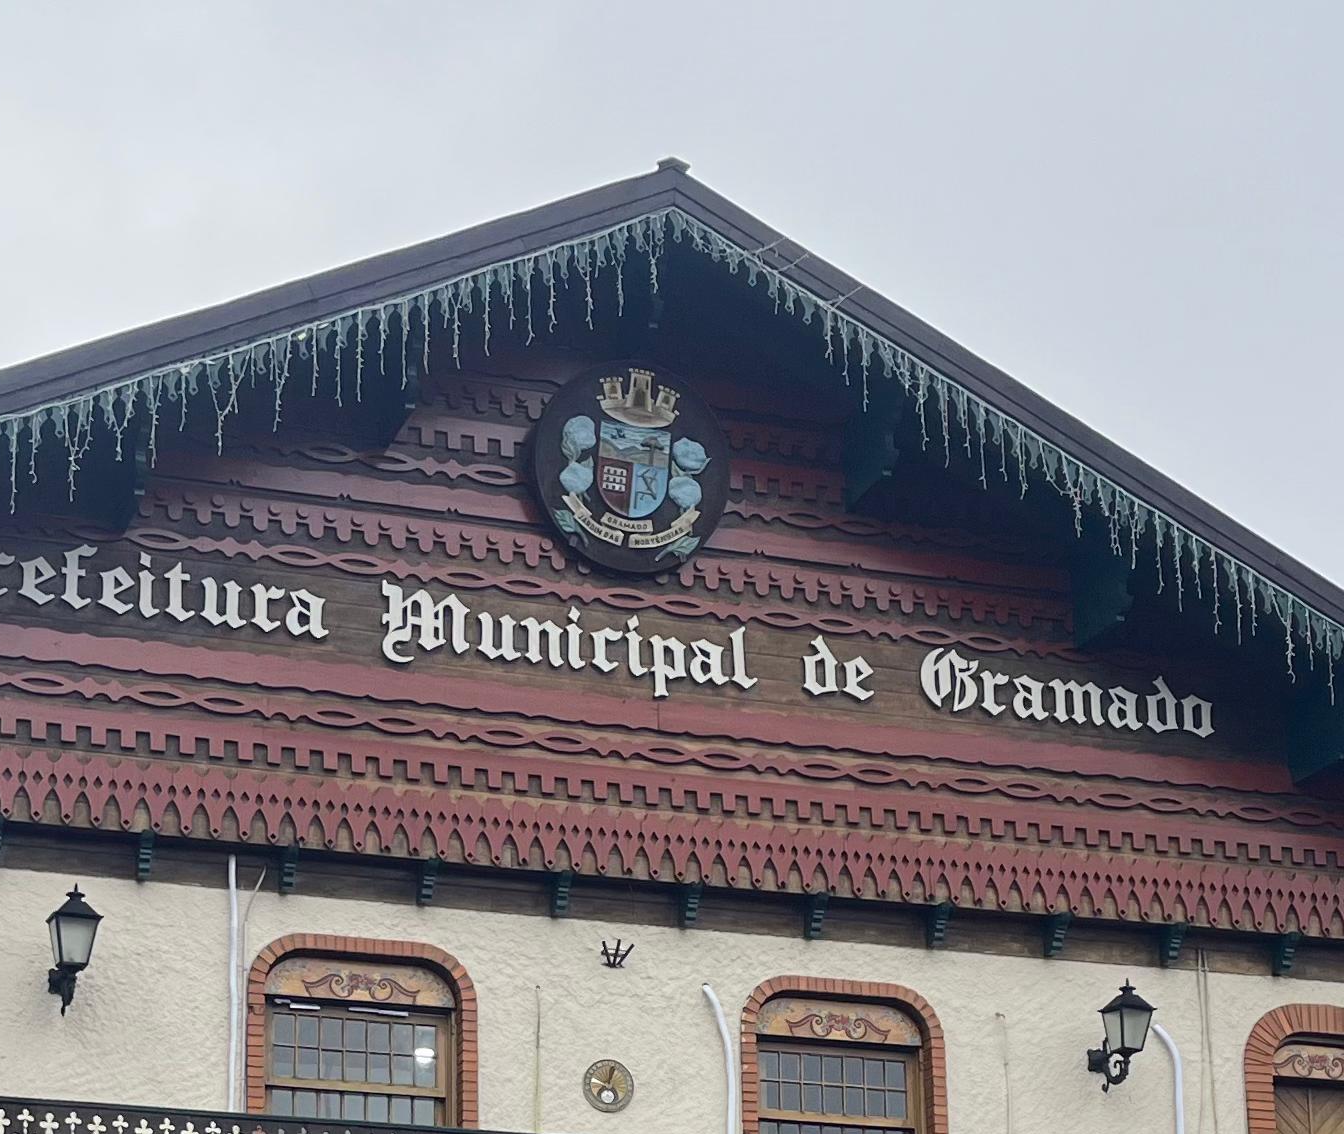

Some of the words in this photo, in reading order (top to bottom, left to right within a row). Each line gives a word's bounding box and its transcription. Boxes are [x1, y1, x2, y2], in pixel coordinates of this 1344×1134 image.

[578, 513, 603, 535] JARDIM
[603, 531, 620, 543] DAS
[607, 516, 648, 530] GRAMADO
[381, 579, 758, 698] Municipal
[801, 634, 875, 701] de
[920, 647, 1217, 738] Gramado
